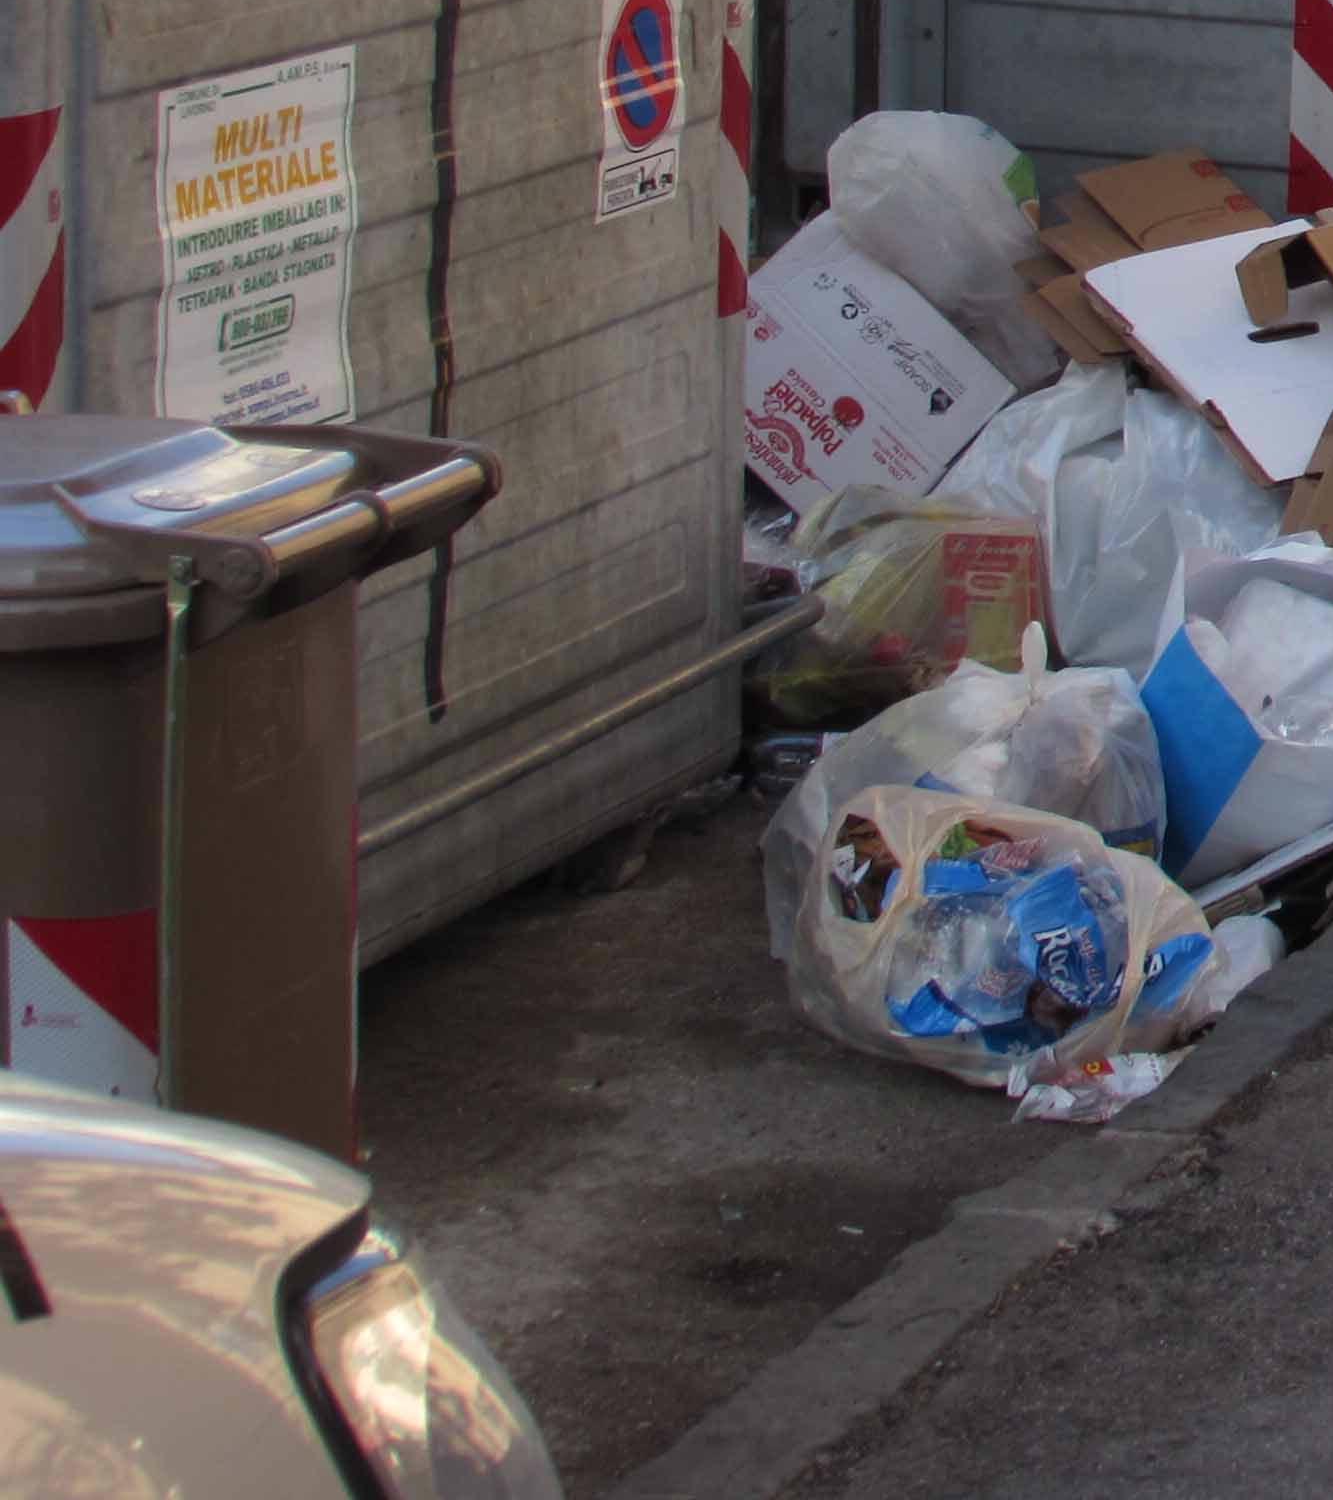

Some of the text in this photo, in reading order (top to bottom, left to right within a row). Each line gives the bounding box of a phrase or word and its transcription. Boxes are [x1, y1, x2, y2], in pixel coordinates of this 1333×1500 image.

[214, 104, 304, 164] MULTI
[175, 140, 340, 223] MATERIALE
[177, 218, 260, 259] INTRODURRE
[262, 200, 328, 235] IMBALLAGI
[763, 378, 844, 458] Polpachef
